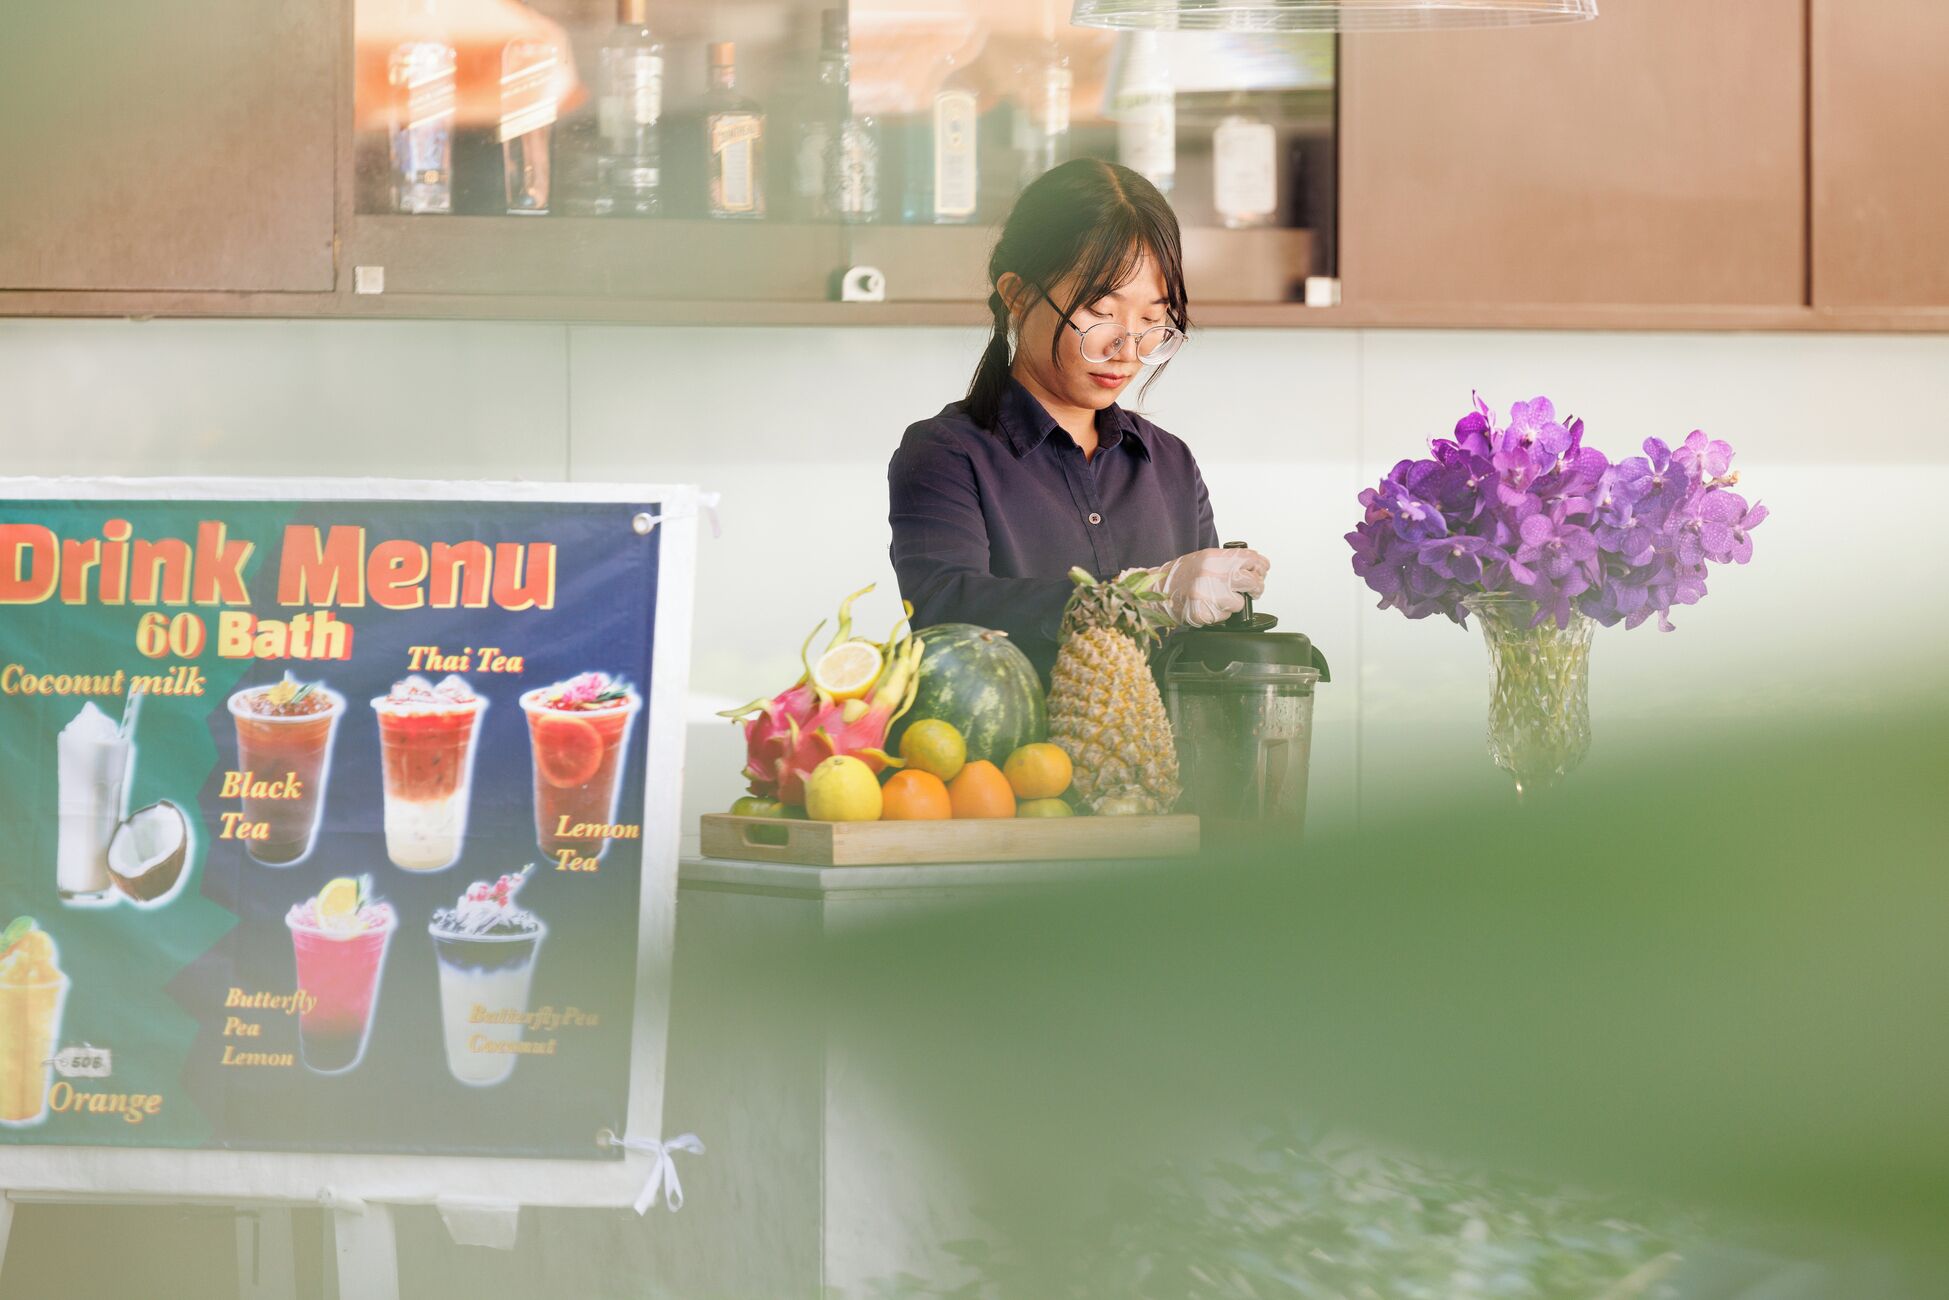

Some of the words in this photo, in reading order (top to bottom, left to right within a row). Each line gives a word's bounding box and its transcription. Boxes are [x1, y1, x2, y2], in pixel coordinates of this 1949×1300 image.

[0, 519, 255, 605] Drink
[277, 525, 557, 611] Menu
[136, 612, 207, 659] 60
[217, 610, 354, 660] Bath
[407, 646, 473, 672] Thai
[476, 647, 525, 673] Tea
[1, 664, 126, 696] Coconut
[130, 666, 208, 695] milk
[219, 771, 304, 799] Black
[219, 812, 271, 840] Tea
[554, 815, 641, 839] Lemon
[555, 848, 599, 872] Tea
[224, 987, 318, 1016] Butterfly
[223, 1016, 262, 1037] Pea
[221, 1045, 295, 1067] Lemon
[48, 1081, 164, 1124] Orange
